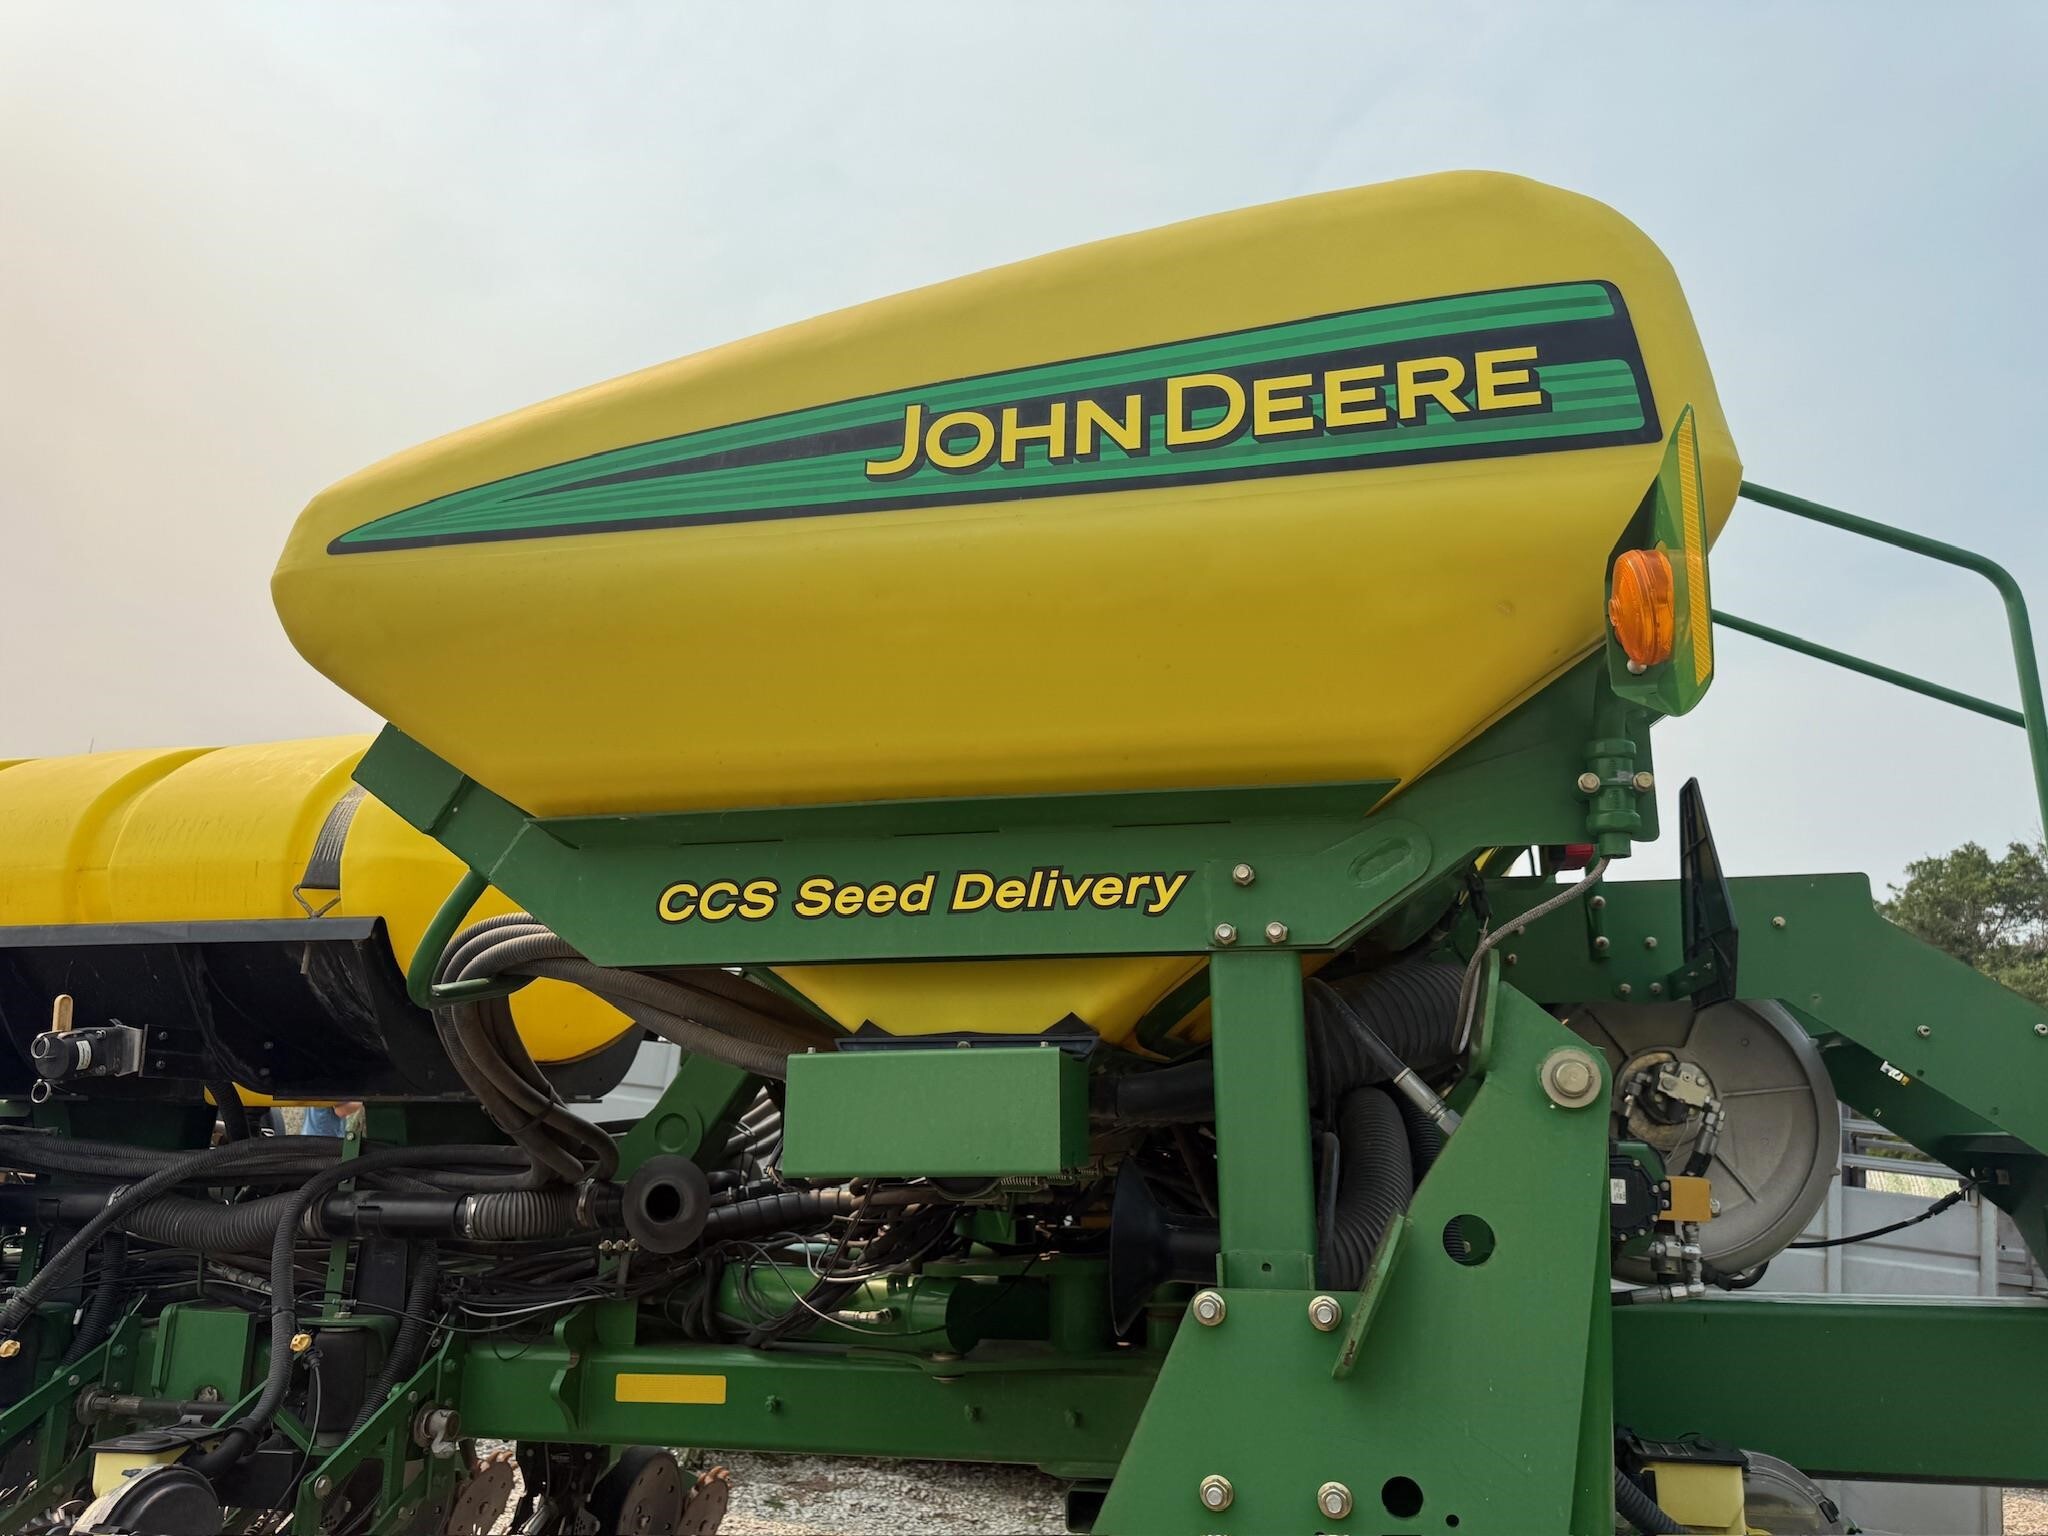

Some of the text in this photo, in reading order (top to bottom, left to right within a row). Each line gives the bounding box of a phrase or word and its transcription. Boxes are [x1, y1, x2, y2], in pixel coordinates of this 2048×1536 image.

[865, 344, 1544, 477] JOHN DEERE
[657, 868, 1189, 923] CCS Seed Delivery
